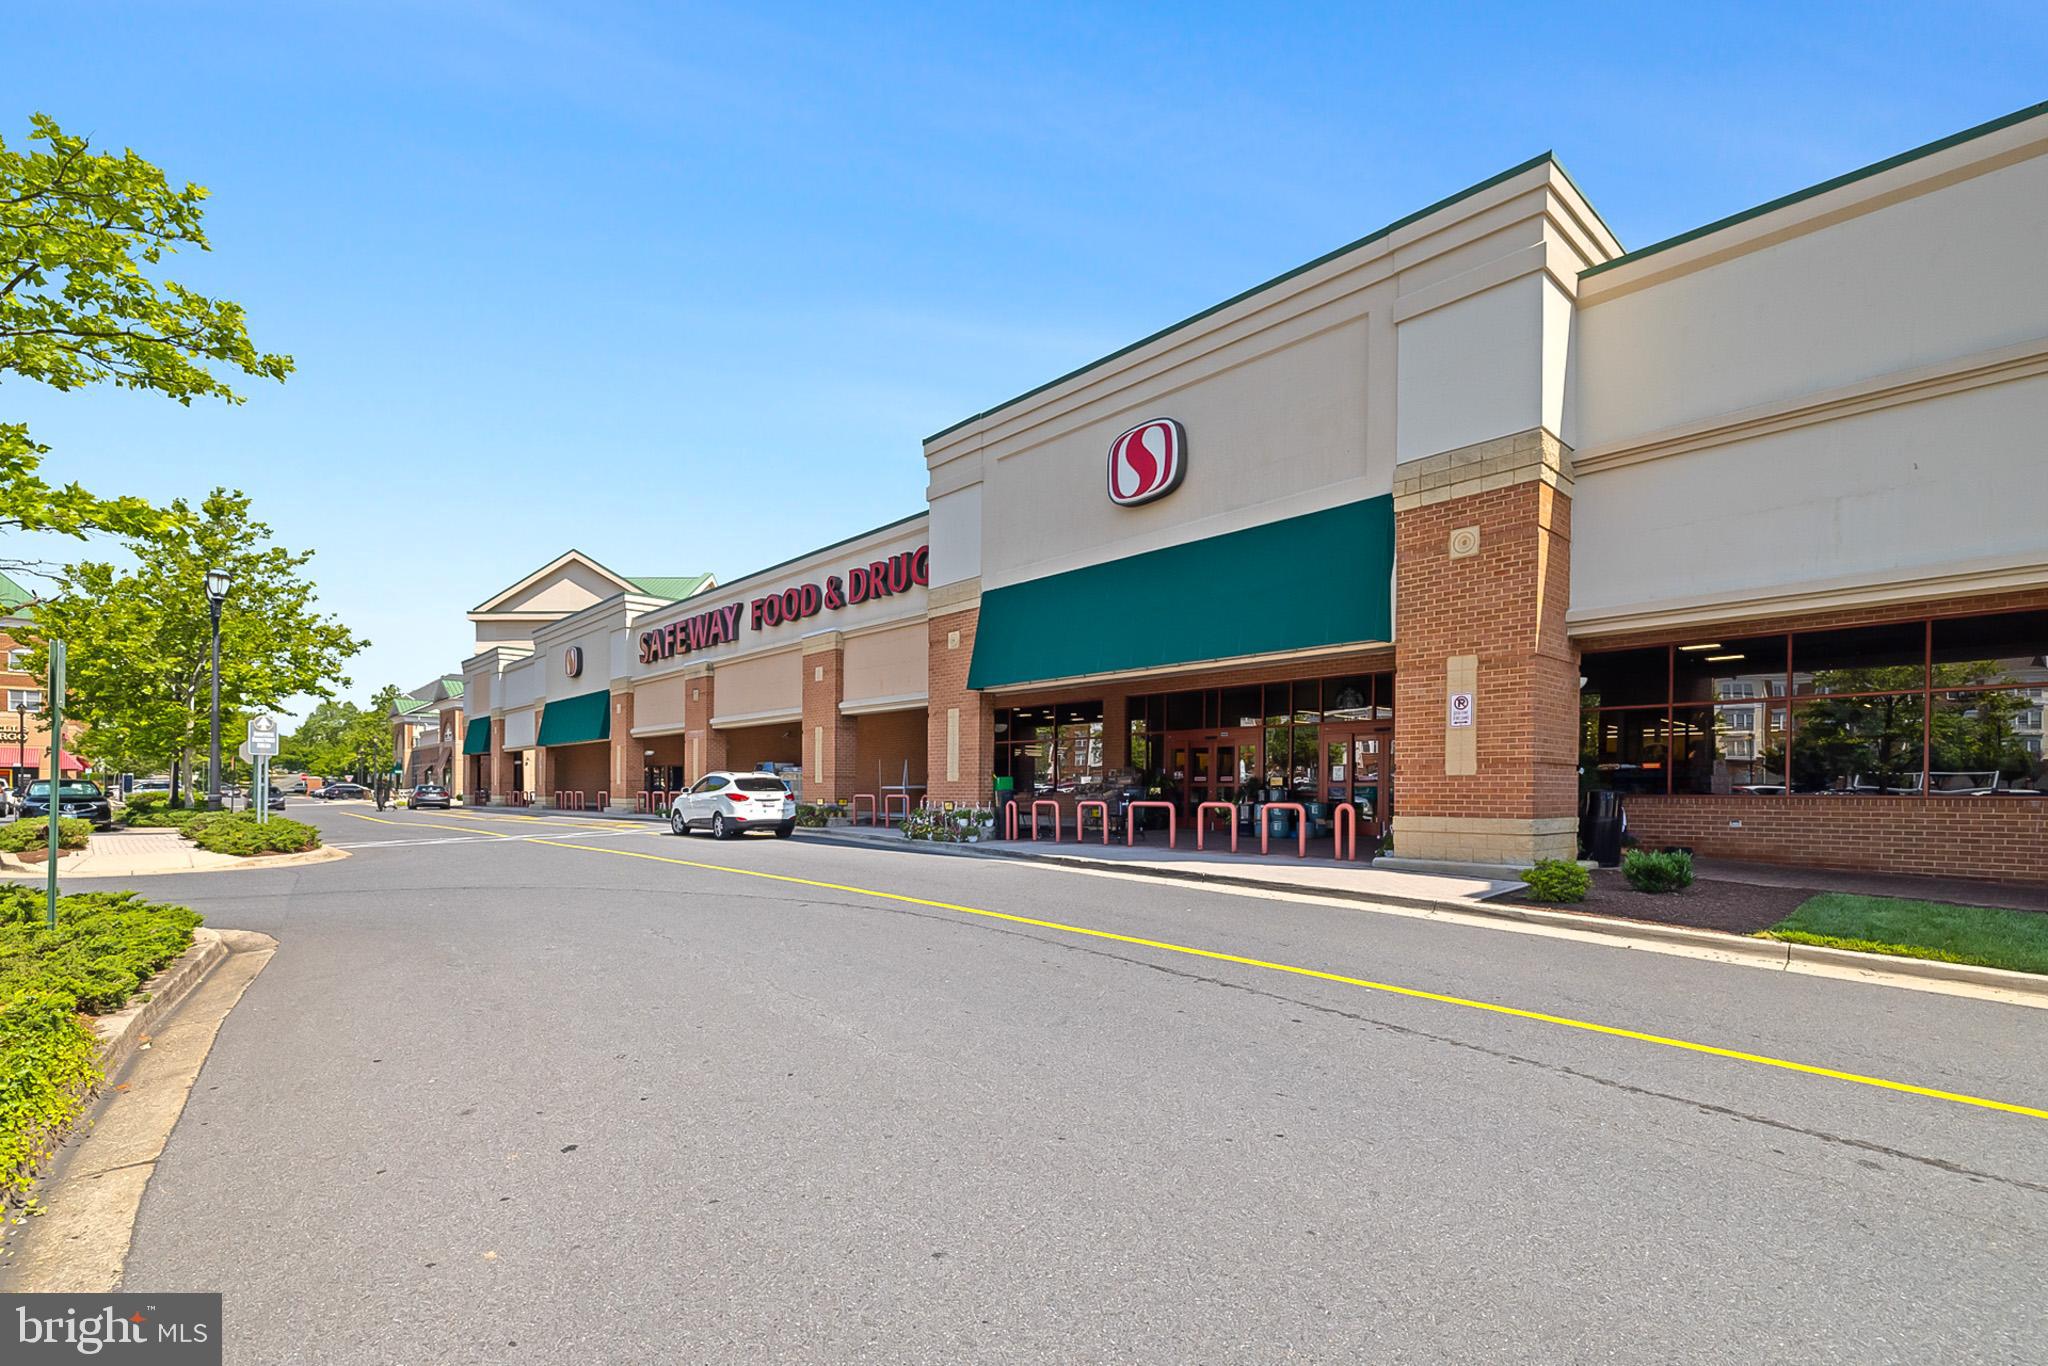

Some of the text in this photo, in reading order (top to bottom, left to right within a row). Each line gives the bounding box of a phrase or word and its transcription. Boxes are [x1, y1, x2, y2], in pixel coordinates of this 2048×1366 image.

[639, 545, 928, 663] SAFEWAY FOOD & DRUG
